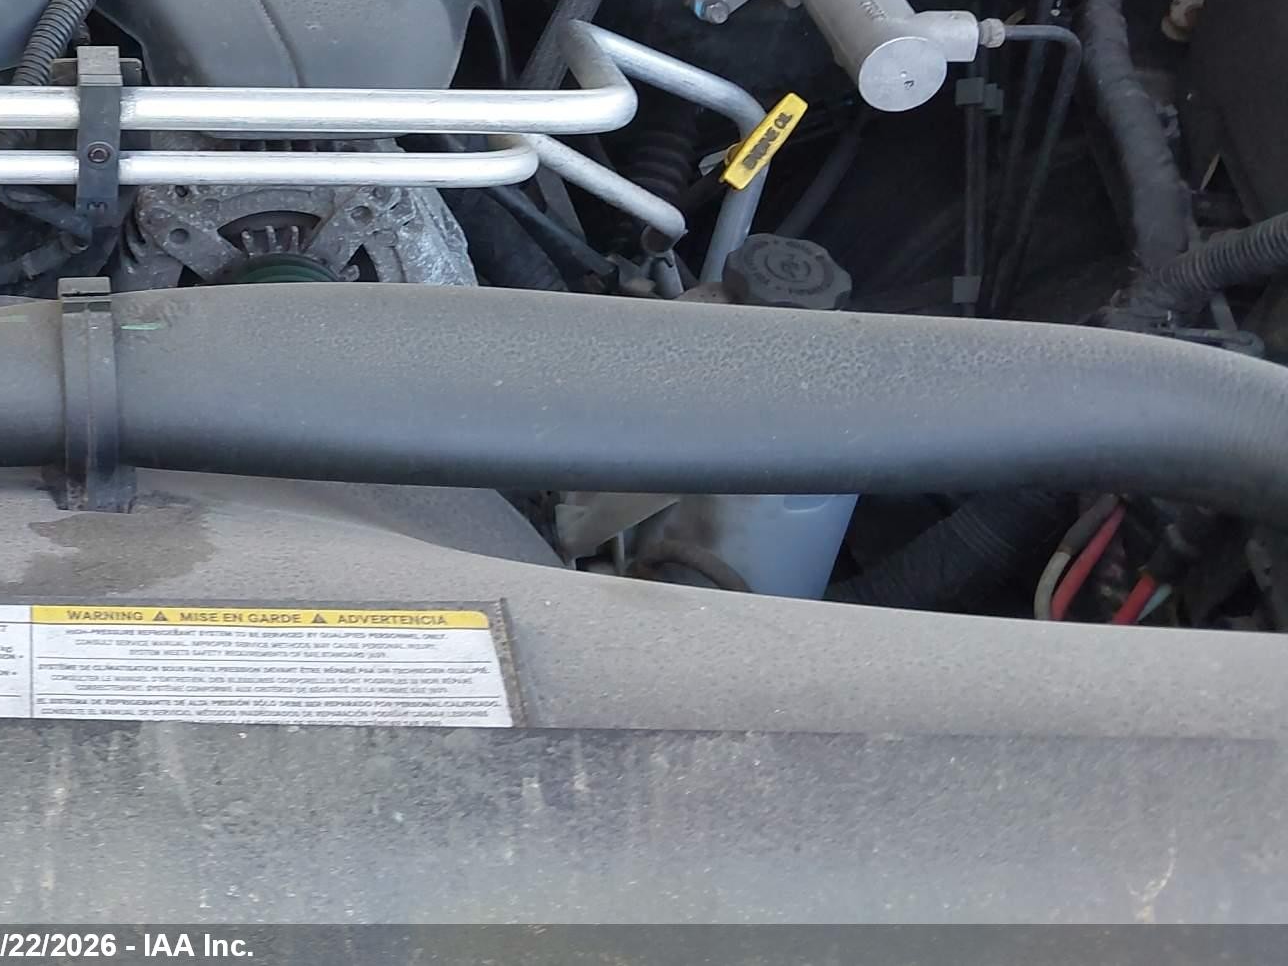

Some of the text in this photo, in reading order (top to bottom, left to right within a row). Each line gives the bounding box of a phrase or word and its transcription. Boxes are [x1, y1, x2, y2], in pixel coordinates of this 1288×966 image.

[66, 610, 447, 625] WARNING MISE EN GARDE ADVERTENCIA
